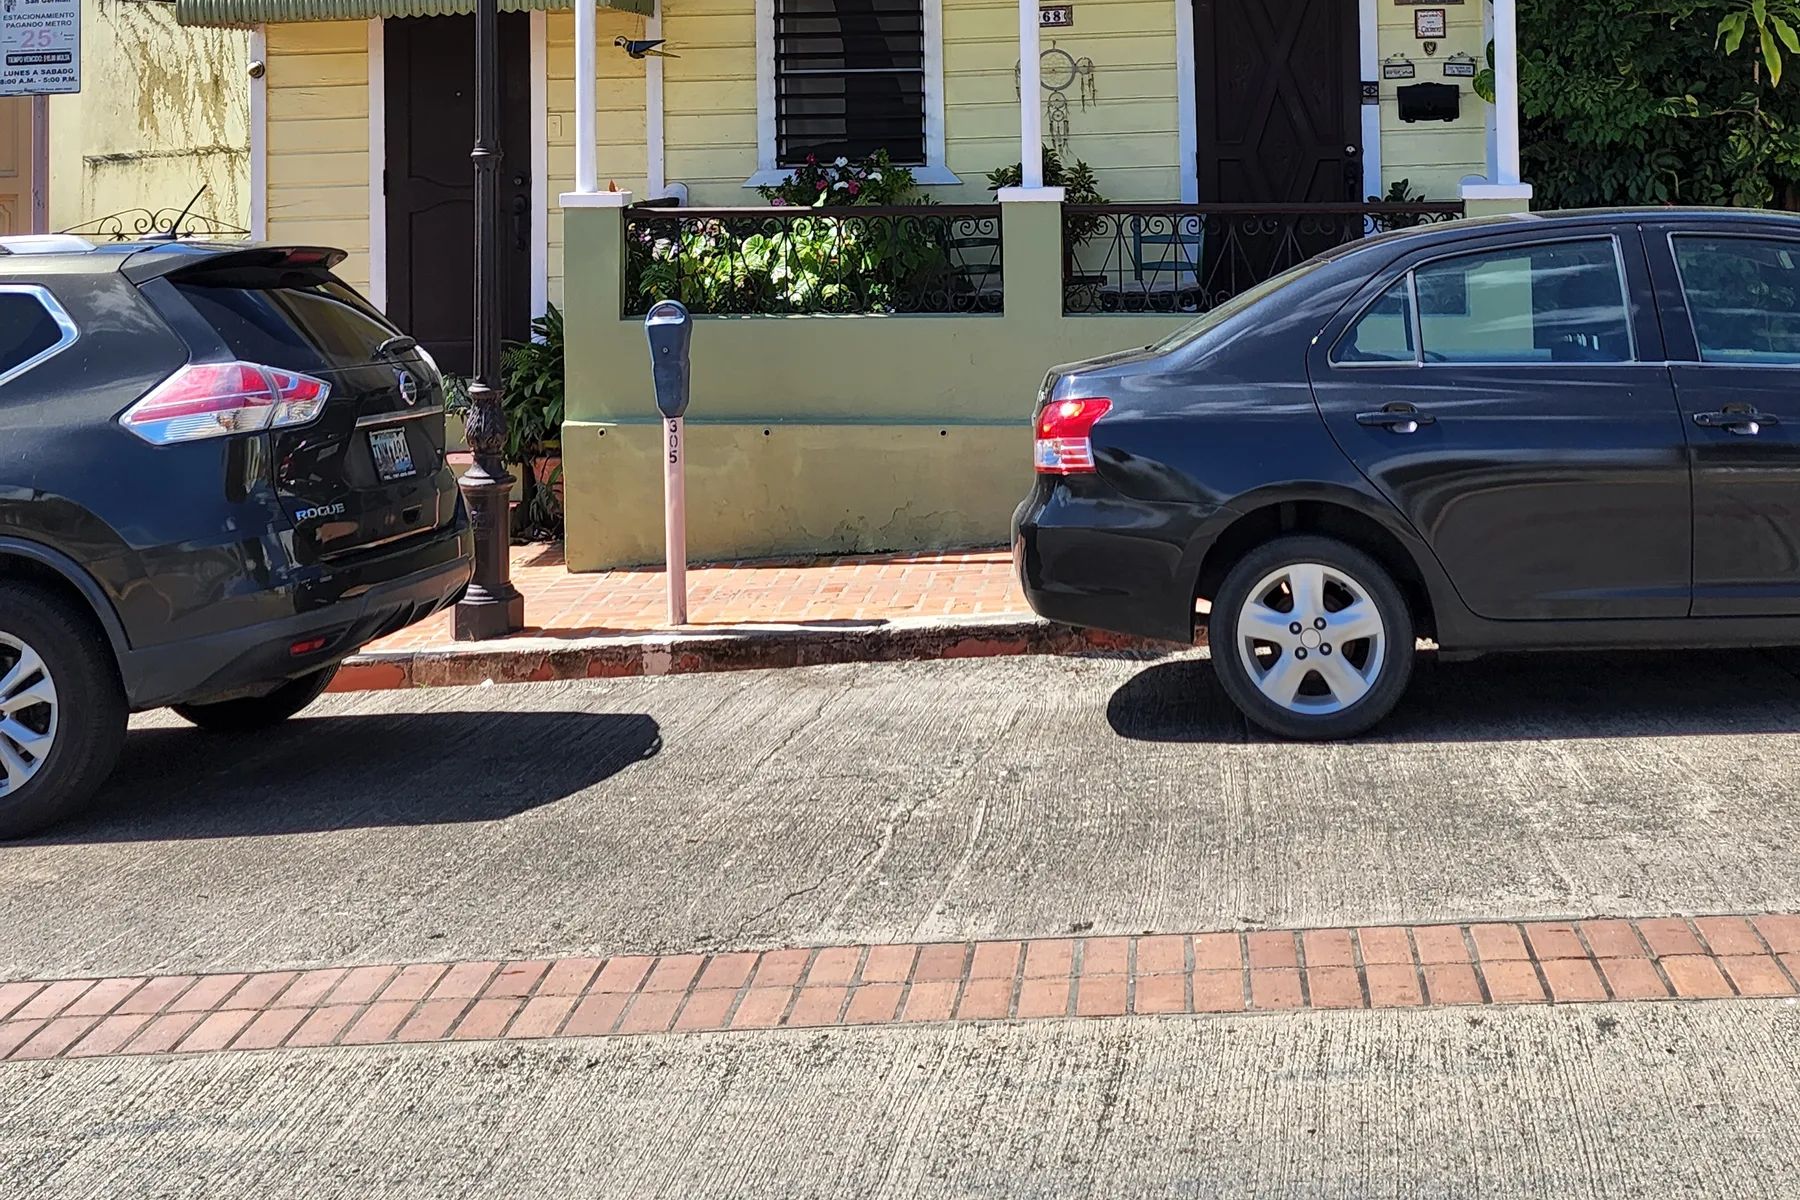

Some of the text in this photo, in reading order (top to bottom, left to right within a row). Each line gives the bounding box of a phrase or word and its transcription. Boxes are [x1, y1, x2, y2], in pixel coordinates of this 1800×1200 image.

[3, 12, 75, 21] ESTACIONAMIENTO
[1042, 10, 1061, 22] 68
[6, 21, 43, 29] PAGANDO
[3, 69, 30, 77] LUNES
[295, 503, 346, 521] ROGUE
